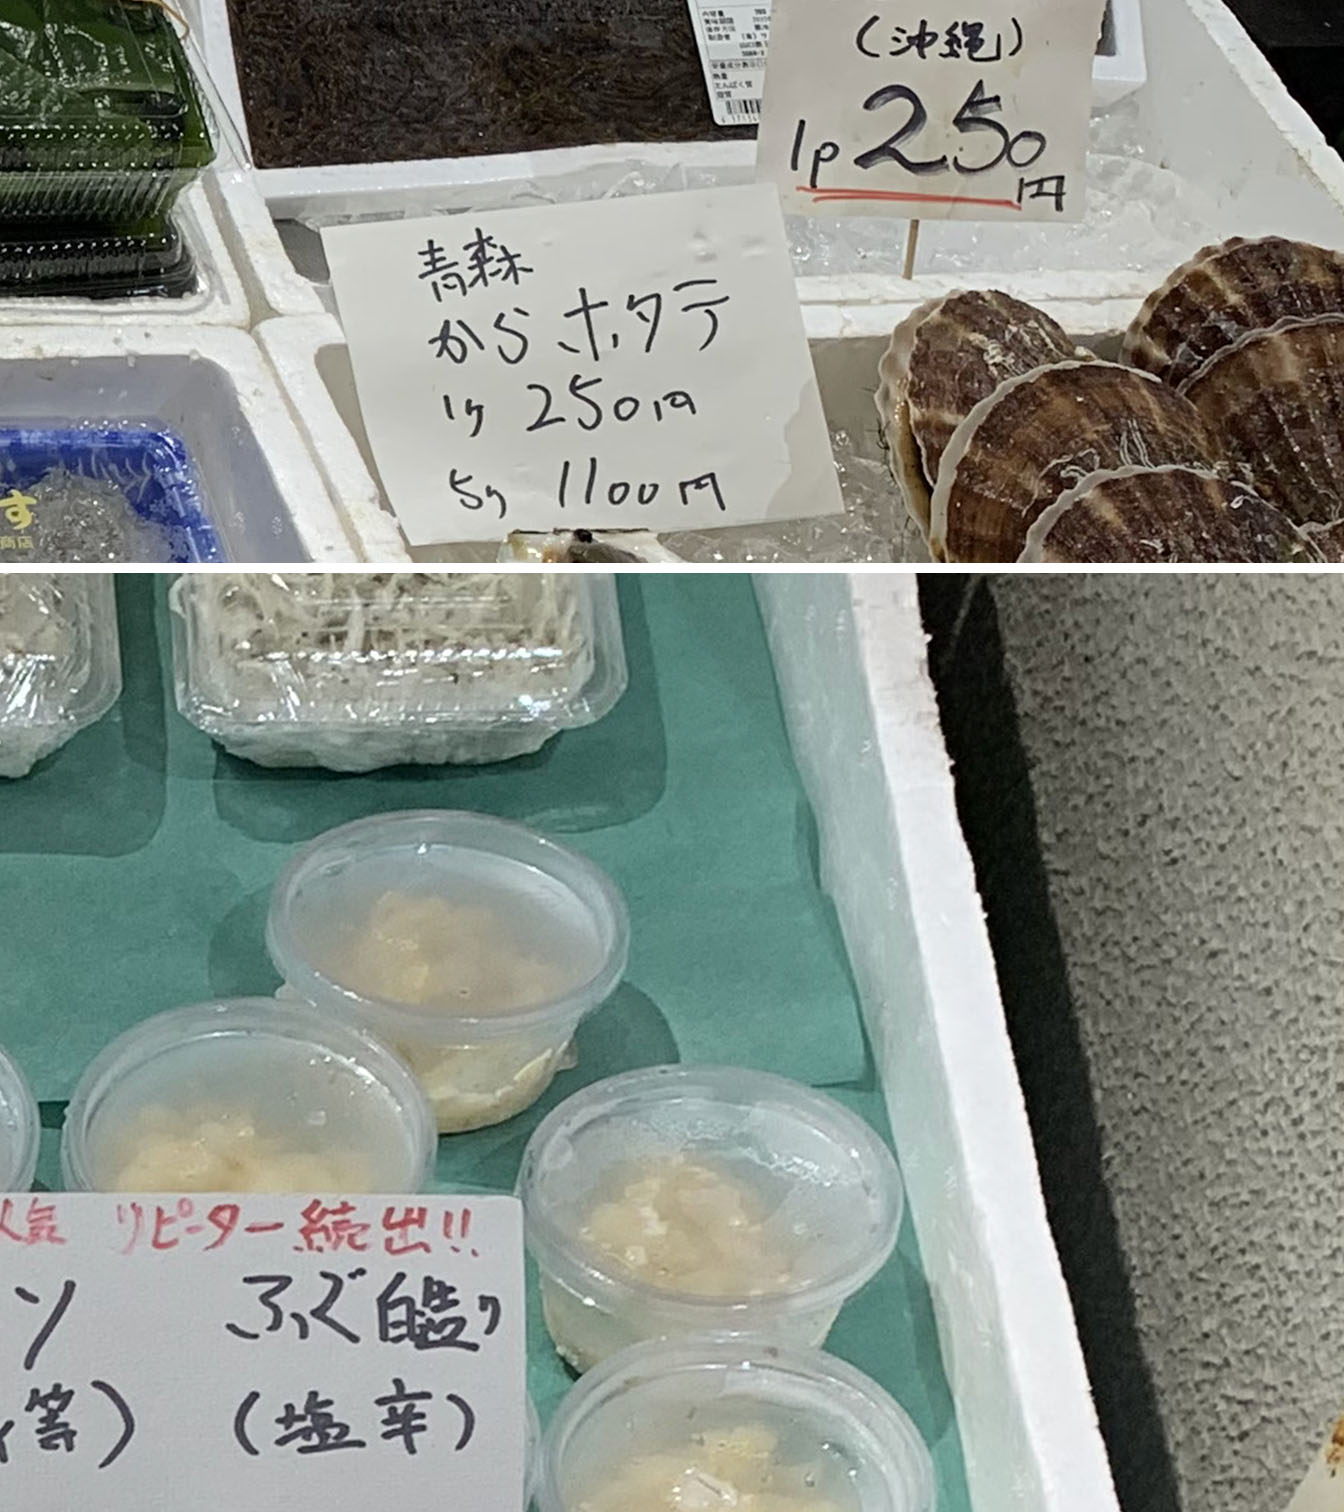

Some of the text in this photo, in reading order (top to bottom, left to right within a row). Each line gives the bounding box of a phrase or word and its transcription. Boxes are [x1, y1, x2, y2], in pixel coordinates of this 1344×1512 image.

[855, 15, 1024, 64] (沖縄)
[853, 80, 1067, 213] 250円
[417, 227, 534, 303] 青森
[525, 373, 698, 432] 250円
[559, 456, 727, 512] 1100円
[234, 1378, 476, 1456] (塩辛)
